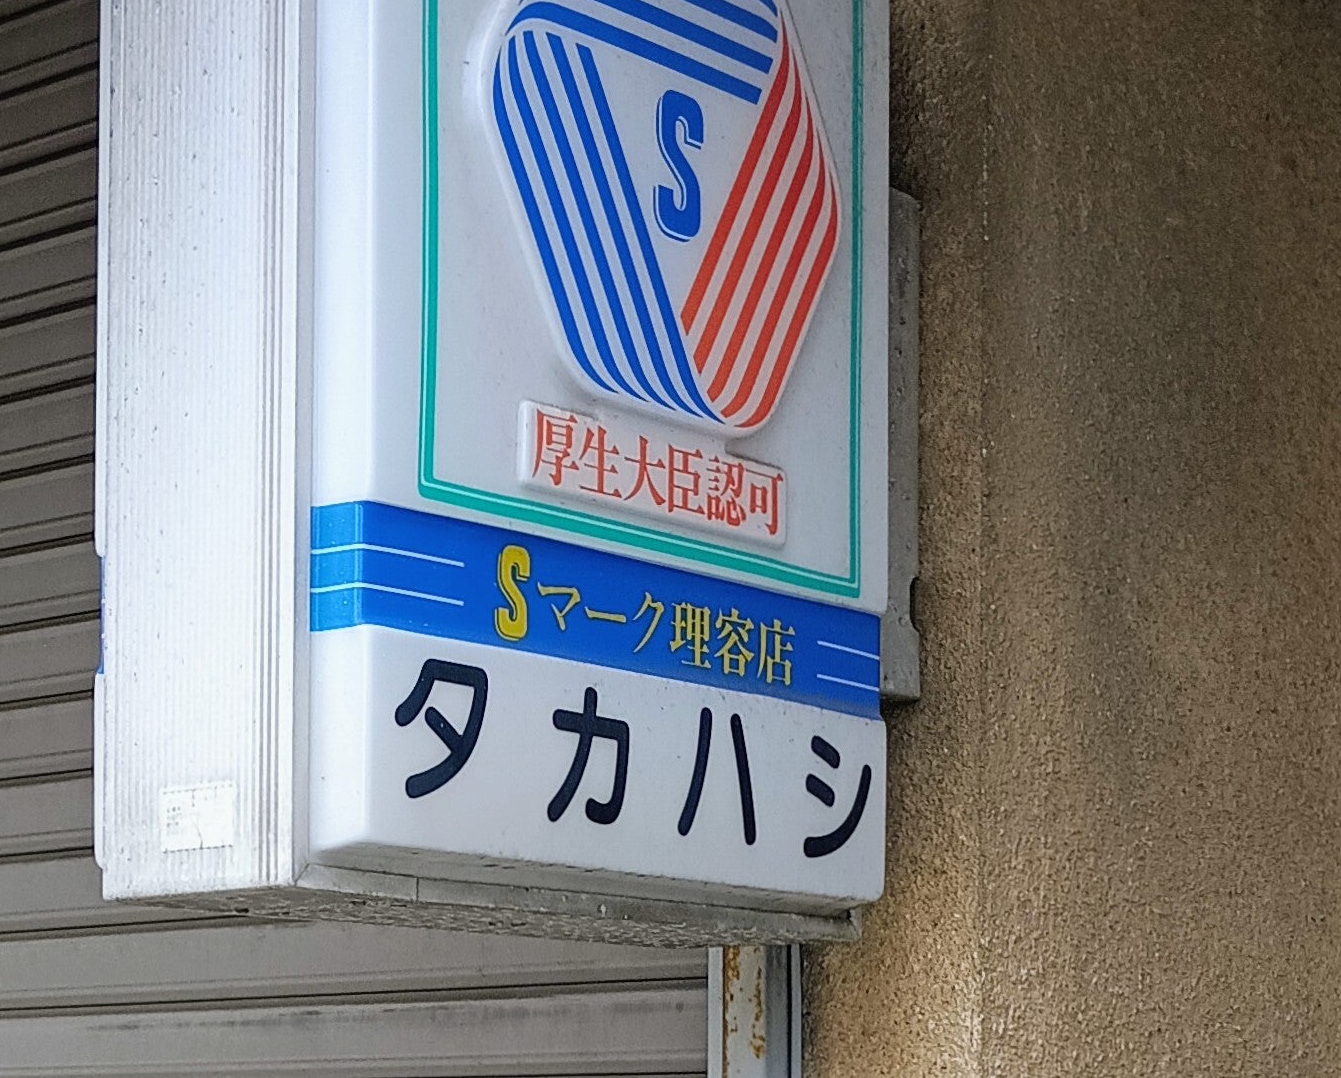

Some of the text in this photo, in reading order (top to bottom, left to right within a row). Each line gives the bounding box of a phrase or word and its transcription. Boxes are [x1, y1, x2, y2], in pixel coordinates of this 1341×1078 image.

[653, 90, 704, 242] S
[532, 409, 784, 536] 厚生大臣認可
[494, 544, 796, 686] Sマーク理容店
[394, 658, 872, 858] タカハシ
